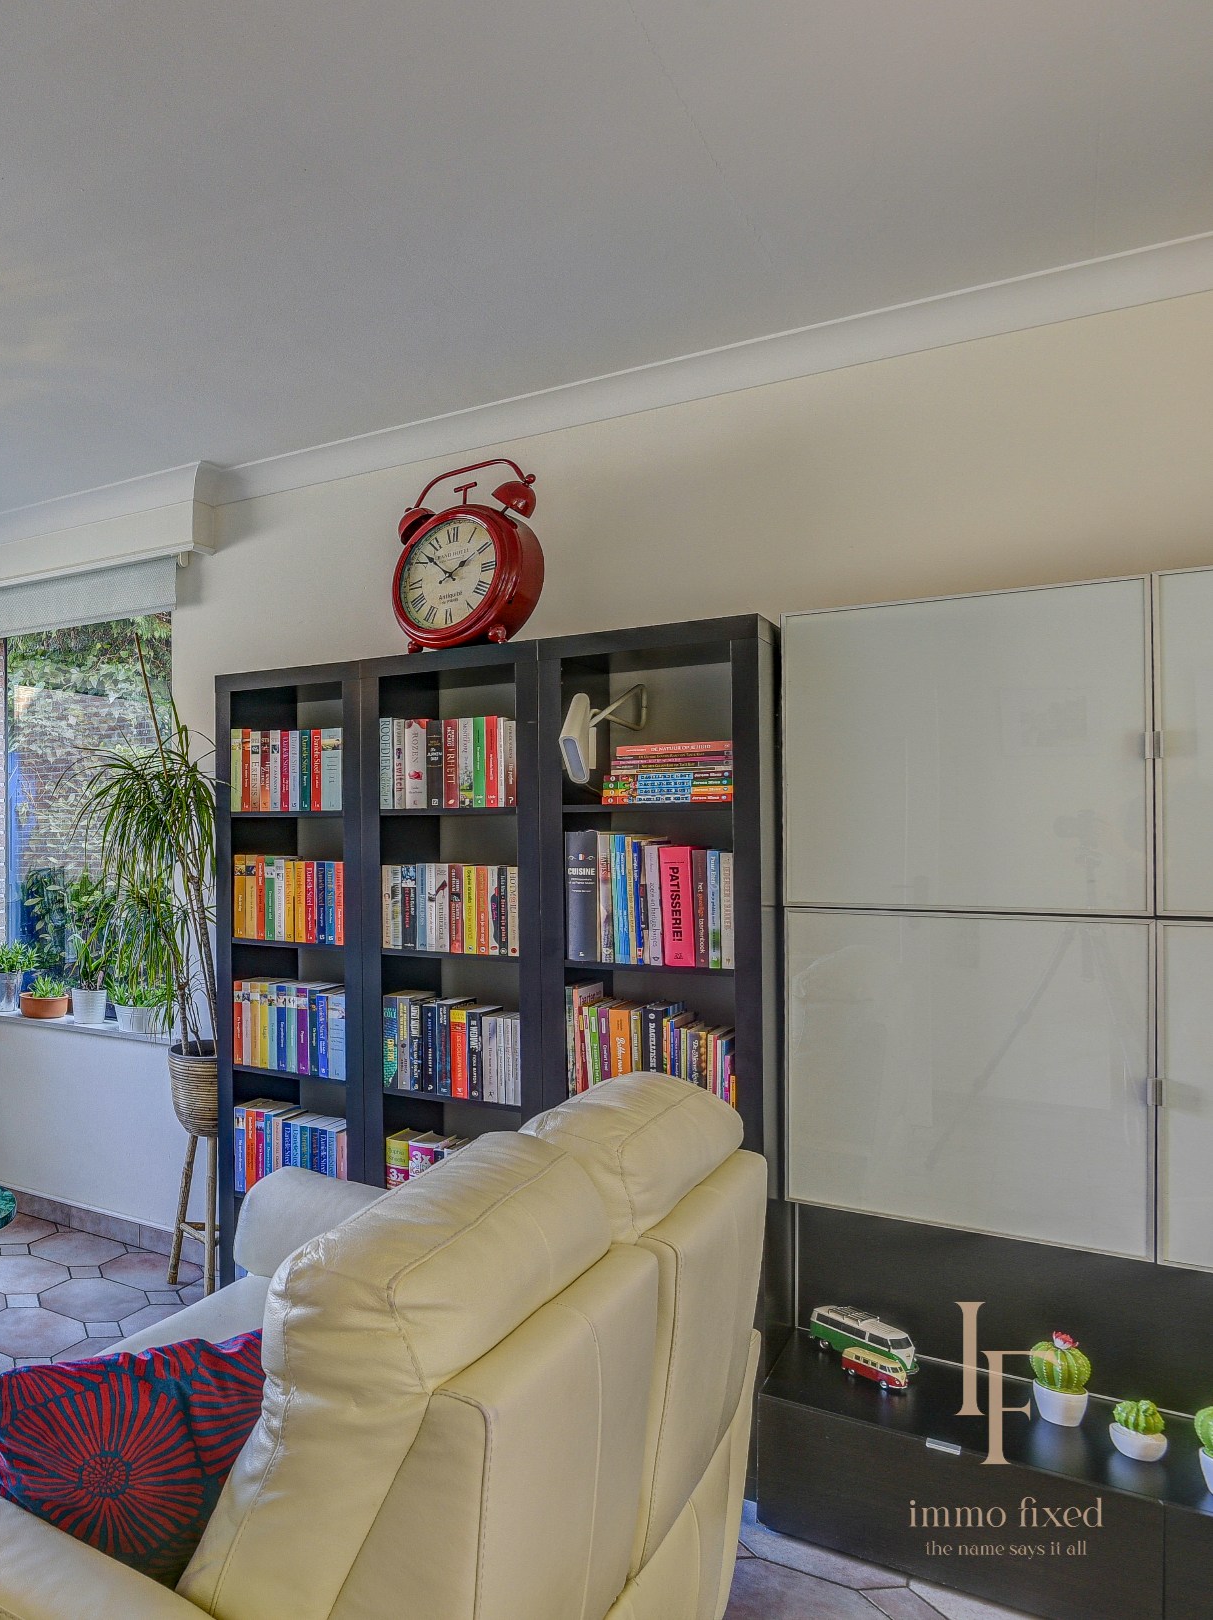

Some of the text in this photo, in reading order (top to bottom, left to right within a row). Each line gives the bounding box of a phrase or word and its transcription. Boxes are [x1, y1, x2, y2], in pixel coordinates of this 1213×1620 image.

[380, 720, 390, 772] ROOFDIER
[251, 760, 260, 798] ERFENIS
[396, 762, 404, 792] switch
[446, 754, 456, 784] RHETT
[568, 868, 596, 876] CUISINE
[668, 866, 682, 942] PATISSERIE!
[650, 908, 659, 928] hartige
[652, 928, 660, 948] hapjes
[470, 1026, 478, 1049] WEDUWE
[648, 1022, 656, 1068] DAGELIJKSE
[412, 1150, 432, 1168] 3x
[390, 1168, 406, 1182] 3x
